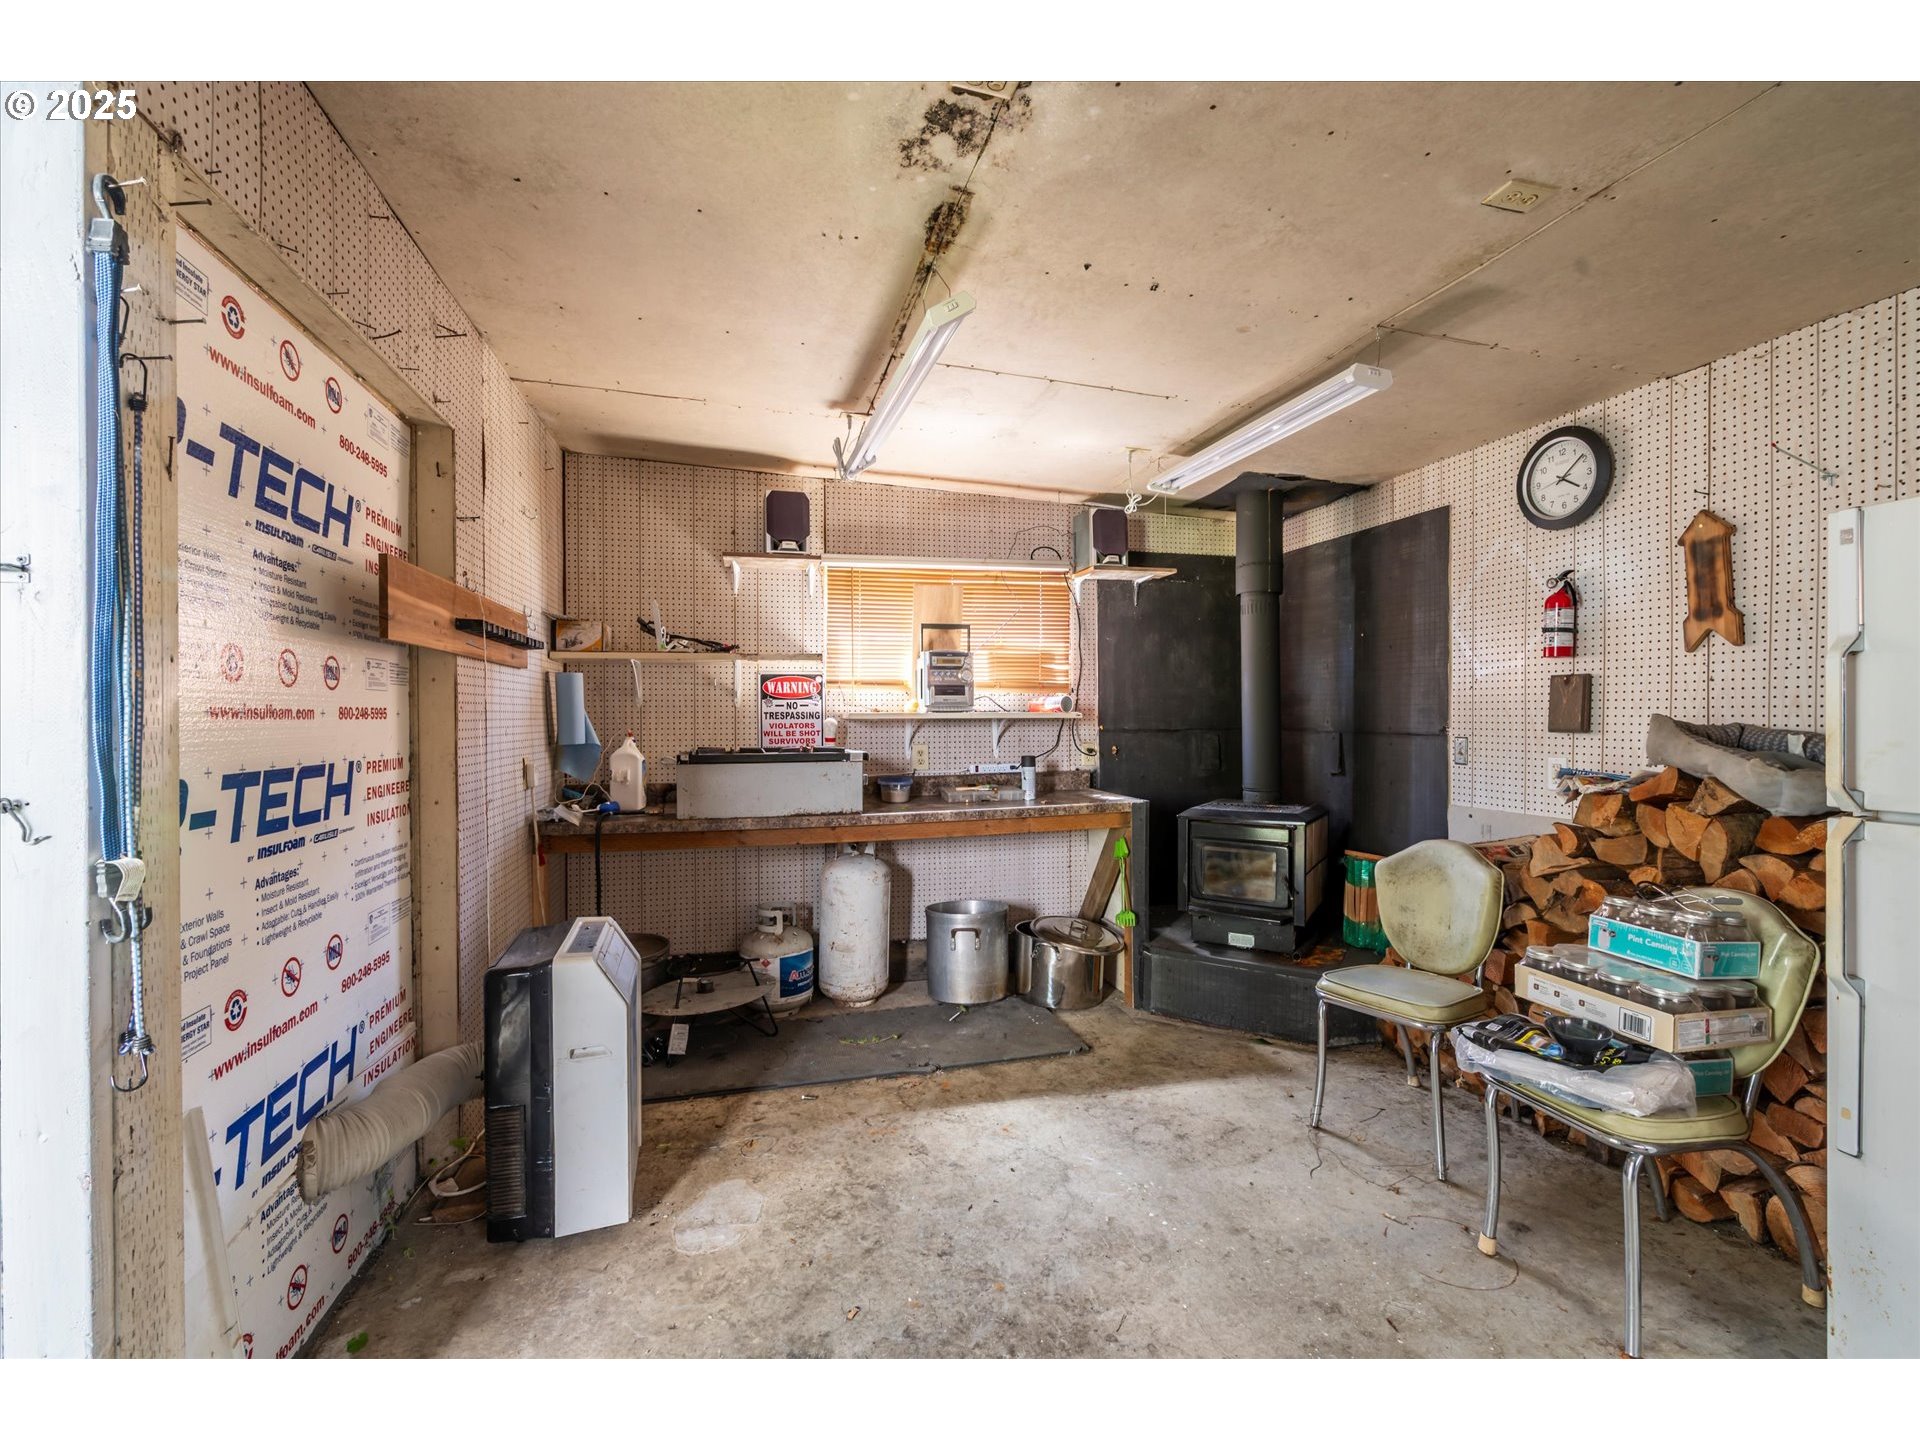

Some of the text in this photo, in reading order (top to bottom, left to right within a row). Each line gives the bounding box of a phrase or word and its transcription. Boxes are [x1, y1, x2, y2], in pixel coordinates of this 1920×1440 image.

[176, 269, 192, 286] NERGY
[208, 346, 316, 430] www.insulfoam.com
[339, 434, 388, 478] 800-248-5995
[1559, 448, 1566, 456] 12
[1540, 466, 1548, 475] 10
[1586, 467, 1592, 476] 3
[1562, 502, 1567, 510] 6
[1574, 494, 1579, 502] 5
[366, 506, 402, 538] PREMIUM
[366, 532, 408, 562] ENGINEERE
[766, 682, 817, 694] WARNING
[209, 704, 315, 720] www.insulfoam.com
[338, 706, 388, 720] 800-248-5995
[786, 702, 798, 710] NO
[366, 757, 404, 774] PREMIUM
[367, 780, 410, 800] ENGINEERE
[255, 868, 300, 890] Advantages:
[261, 878, 309, 902] Moisture Resistant
[261, 904, 278, 917] Insect
[284, 896, 298, 908] Mold
[298, 887, 320, 900] Resistant
[206, 909, 224, 923] Walls
[180, 924, 230, 950] & Crawl Space
[1628, 934, 1643, 945] Pint
[1645, 938, 1678, 955] Canning
[182, 938, 232, 966] & Foundations
[184, 952, 229, 982] Project Panel
[342, 950, 390, 994] 800-248-5995
[370, 988, 406, 1029] PREMIUM
[181, 1028, 196, 1043] ERGY
[213, 1000, 318, 1081] www.insulfoam.com
[370, 1008, 413, 1055] ENGINEERE
[364, 1035, 416, 1088] INSULATION
[261, 1180, 300, 1224] Advantage
[276, 1296, 325, 1359] foam.com
